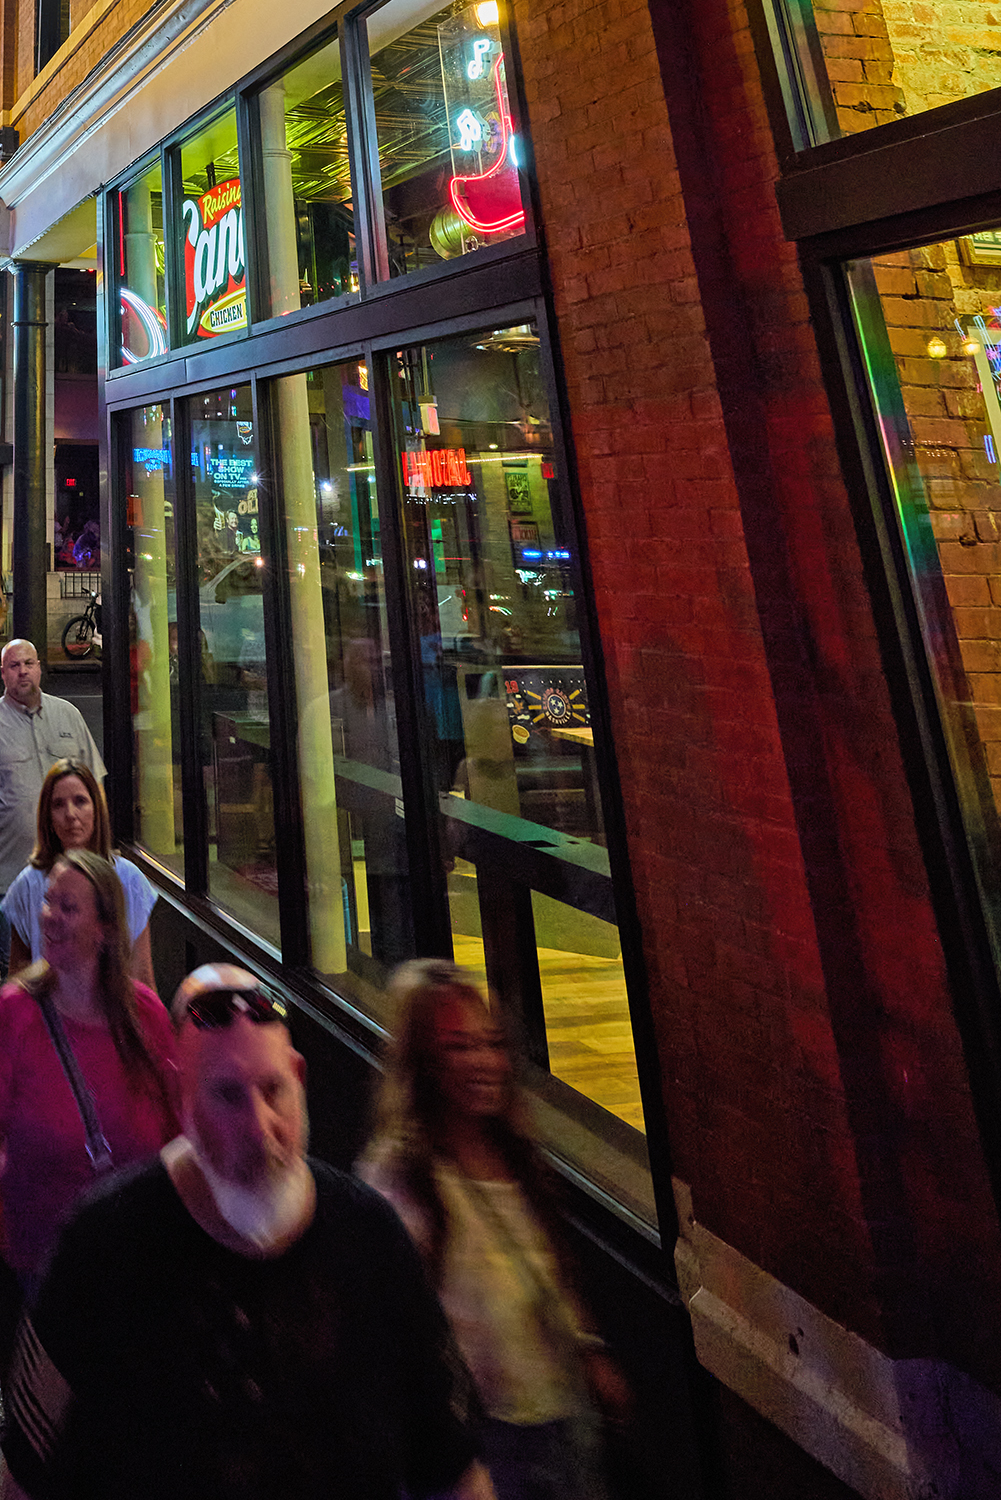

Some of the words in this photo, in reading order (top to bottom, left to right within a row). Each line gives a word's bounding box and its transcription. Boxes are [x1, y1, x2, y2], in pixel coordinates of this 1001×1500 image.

[182, 199, 245, 334] an
[209, 304, 243, 327] CHICKEN
[210, 458, 228, 466] THE
[228, 459, 252, 467] BEST
[213, 472, 227, 480] ON
[545, 710, 571, 725] NASHVILLE
